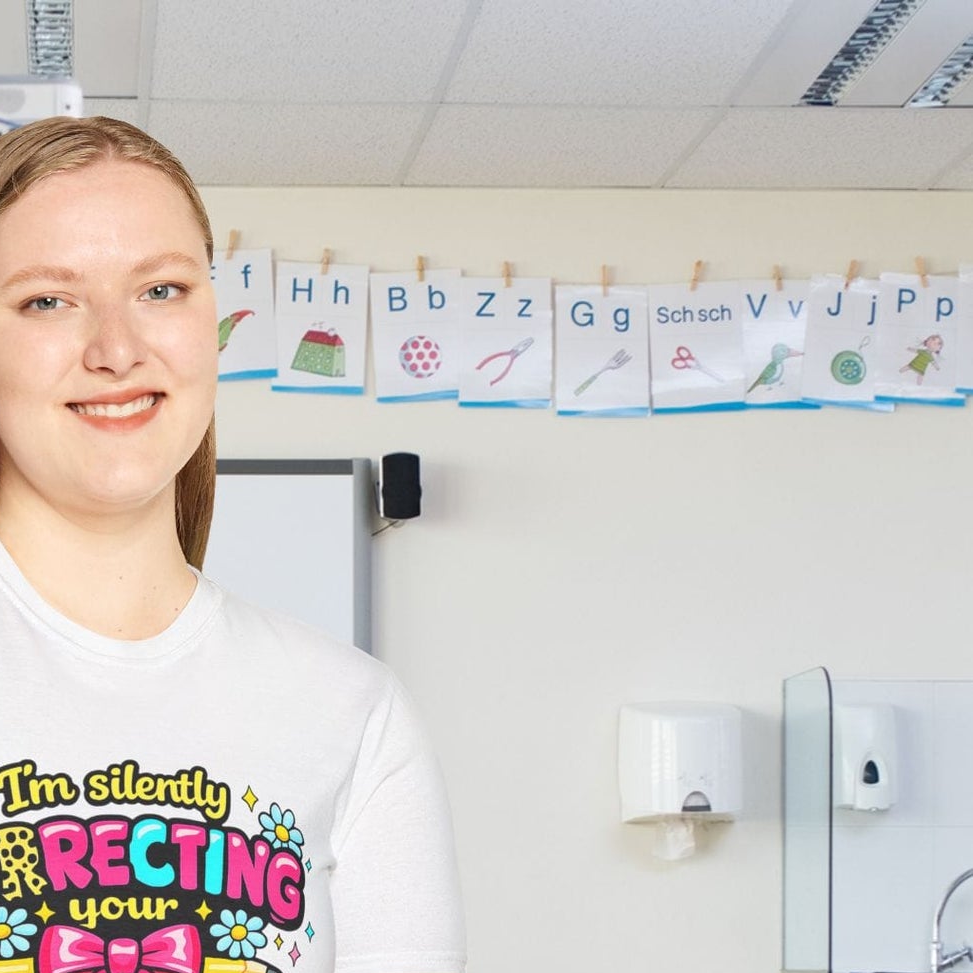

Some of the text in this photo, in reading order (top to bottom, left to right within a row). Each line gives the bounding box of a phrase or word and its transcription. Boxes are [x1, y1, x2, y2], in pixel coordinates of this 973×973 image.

[241, 264, 252, 289] f
[291, 277, 350, 305] H h
[388, 284, 446, 312] B b
[475, 292, 532, 318] Z z
[897, 288, 954, 322] P p
[570, 300, 630, 333] G g
[656, 304, 732, 324] Sch sch
[746, 293, 804, 319] V v
[826, 291, 877, 326] J j
[87, 763, 227, 820] silently
[68, 896, 179, 929] your
